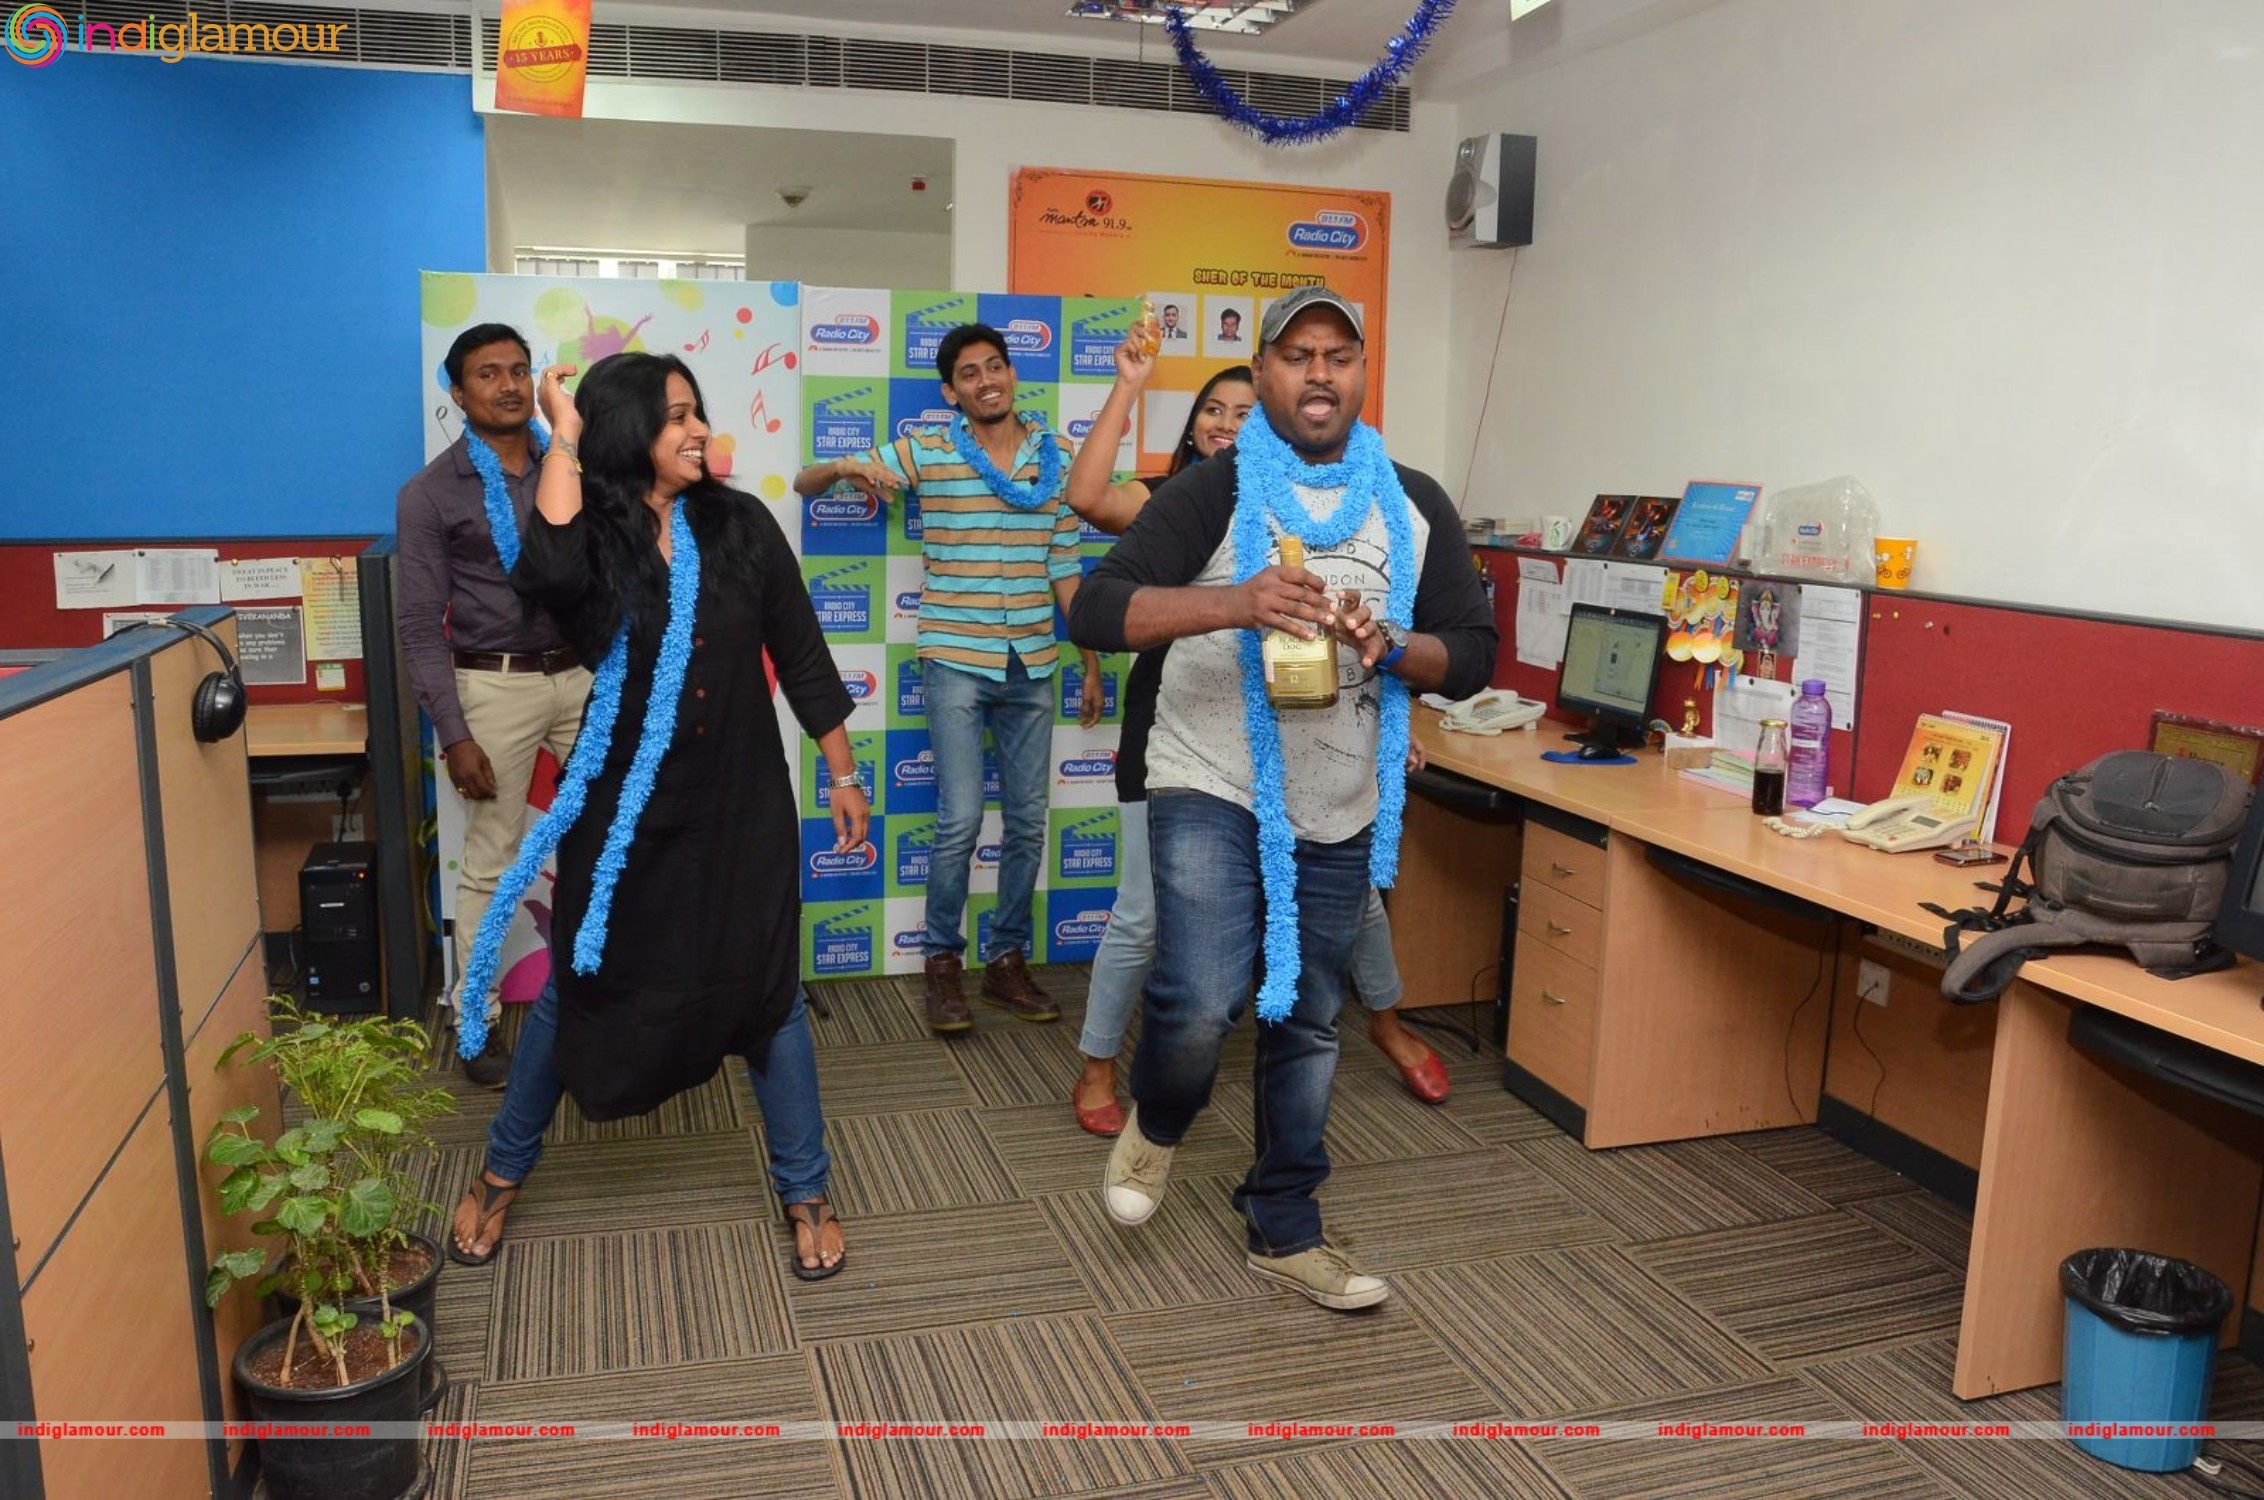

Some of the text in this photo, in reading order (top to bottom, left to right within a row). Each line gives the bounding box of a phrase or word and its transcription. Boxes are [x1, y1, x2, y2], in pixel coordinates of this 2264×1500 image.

[515, 49, 571, 64] 15 YEARS
[1294, 228, 1357, 249] Radio City
[1194, 268, 1228, 286] SHER
[1231, 270, 1248, 287] OF
[1251, 271, 1279, 288] THE
[815, 328, 870, 342] Radio City
[1021, 334, 1042, 349] City
[908, 347, 930, 359] STAR
[1073, 354, 1116, 366] STAR EXPRE
[816, 436, 871, 448] STAR EXPRESS
[816, 504, 868, 517] Radio City
[900, 596, 921, 606] Rad
[816, 610, 867, 622] TAR EXPRESS
[900, 694, 922, 707] STAR
[900, 764, 930, 775] Radio
[1063, 762, 1114, 775] Radio City
[816, 855, 868, 867] Radio City
[1063, 857, 1113, 870] STAR EXPRESS
[900, 865, 919, 877] STAR
[1061, 923, 1089, 935] Radio
[816, 951, 870, 965] STAR EXPRESS
